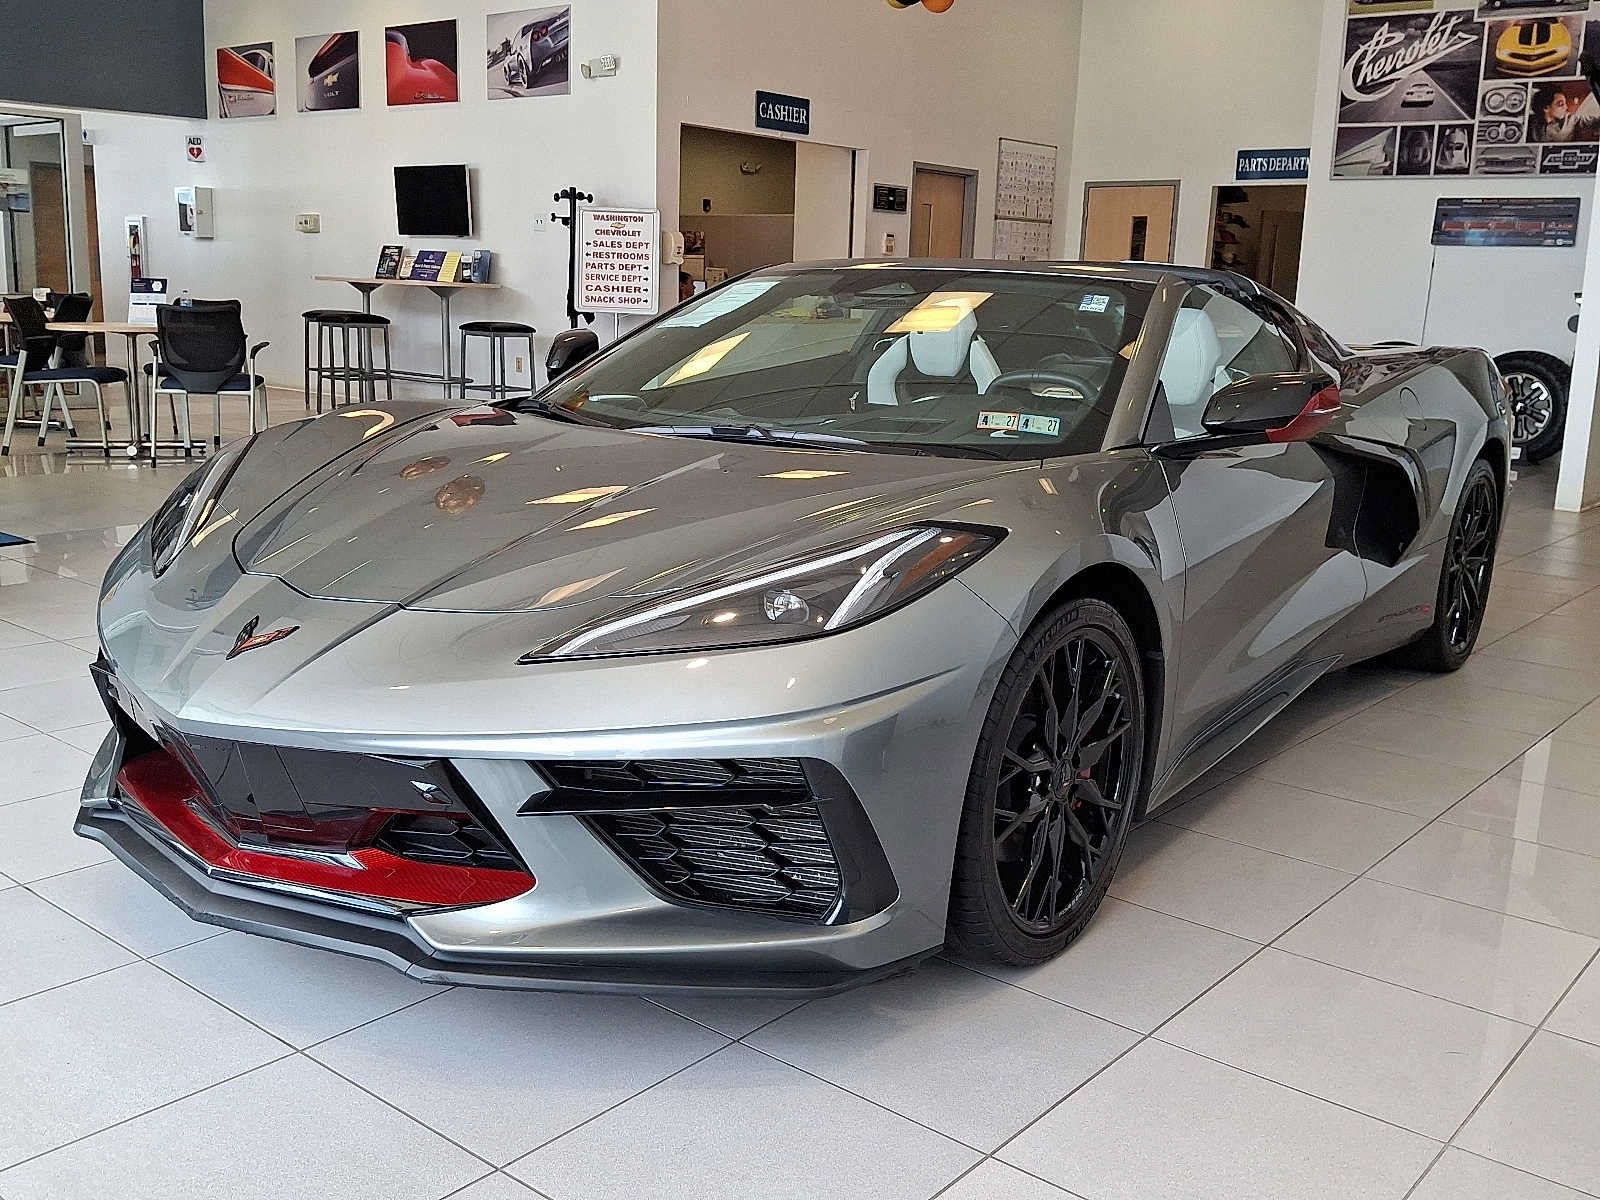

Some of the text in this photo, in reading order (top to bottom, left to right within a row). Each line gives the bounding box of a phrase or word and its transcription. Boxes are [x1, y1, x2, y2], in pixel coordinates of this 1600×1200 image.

[1341, 12, 1478, 101] Chevrolet
[759, 102, 807, 124] CASHIER
[187, 137, 202, 145] AED
[1238, 157, 1268, 172] PARTS
[593, 214, 644, 223] WASHINGTON
[594, 229, 642, 237] CHEVROLET
[592, 240, 650, 250] SALES DEPT
[592, 251, 650, 261] RESTROOMS
[585, 262, 642, 271] PARTS DEPT
[585, 273, 642, 282] SERVICE DEPT
[585, 284, 642, 293] CASHIER
[585, 295, 642, 304] SNACK SHOP
[982, 416, 1016, 427] 4 27
[1022, 419, 1057, 432] 4 27
